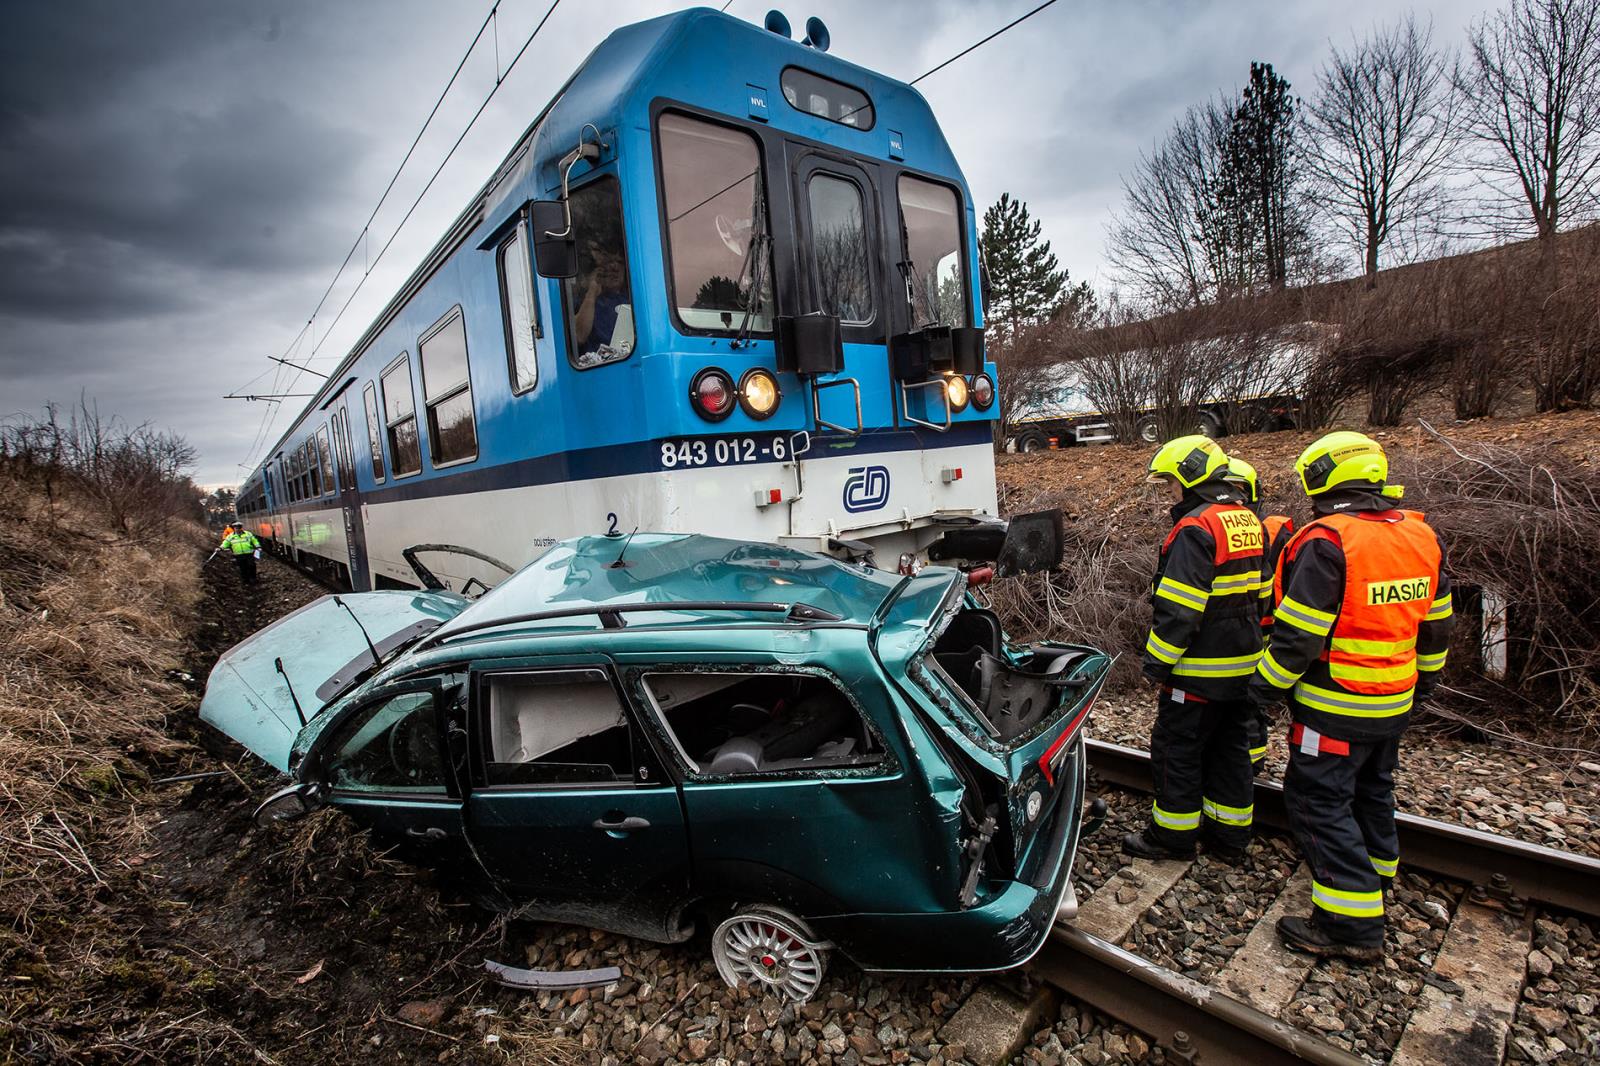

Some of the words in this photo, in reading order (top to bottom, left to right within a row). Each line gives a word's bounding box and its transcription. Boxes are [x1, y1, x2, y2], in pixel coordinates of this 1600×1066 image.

[750, 97, 766, 108] NVL
[890, 140, 902, 150] NVL
[661, 440, 708, 468] 843
[606, 512, 619, 534] 2
[1371, 578, 1429, 605] HASIČI
